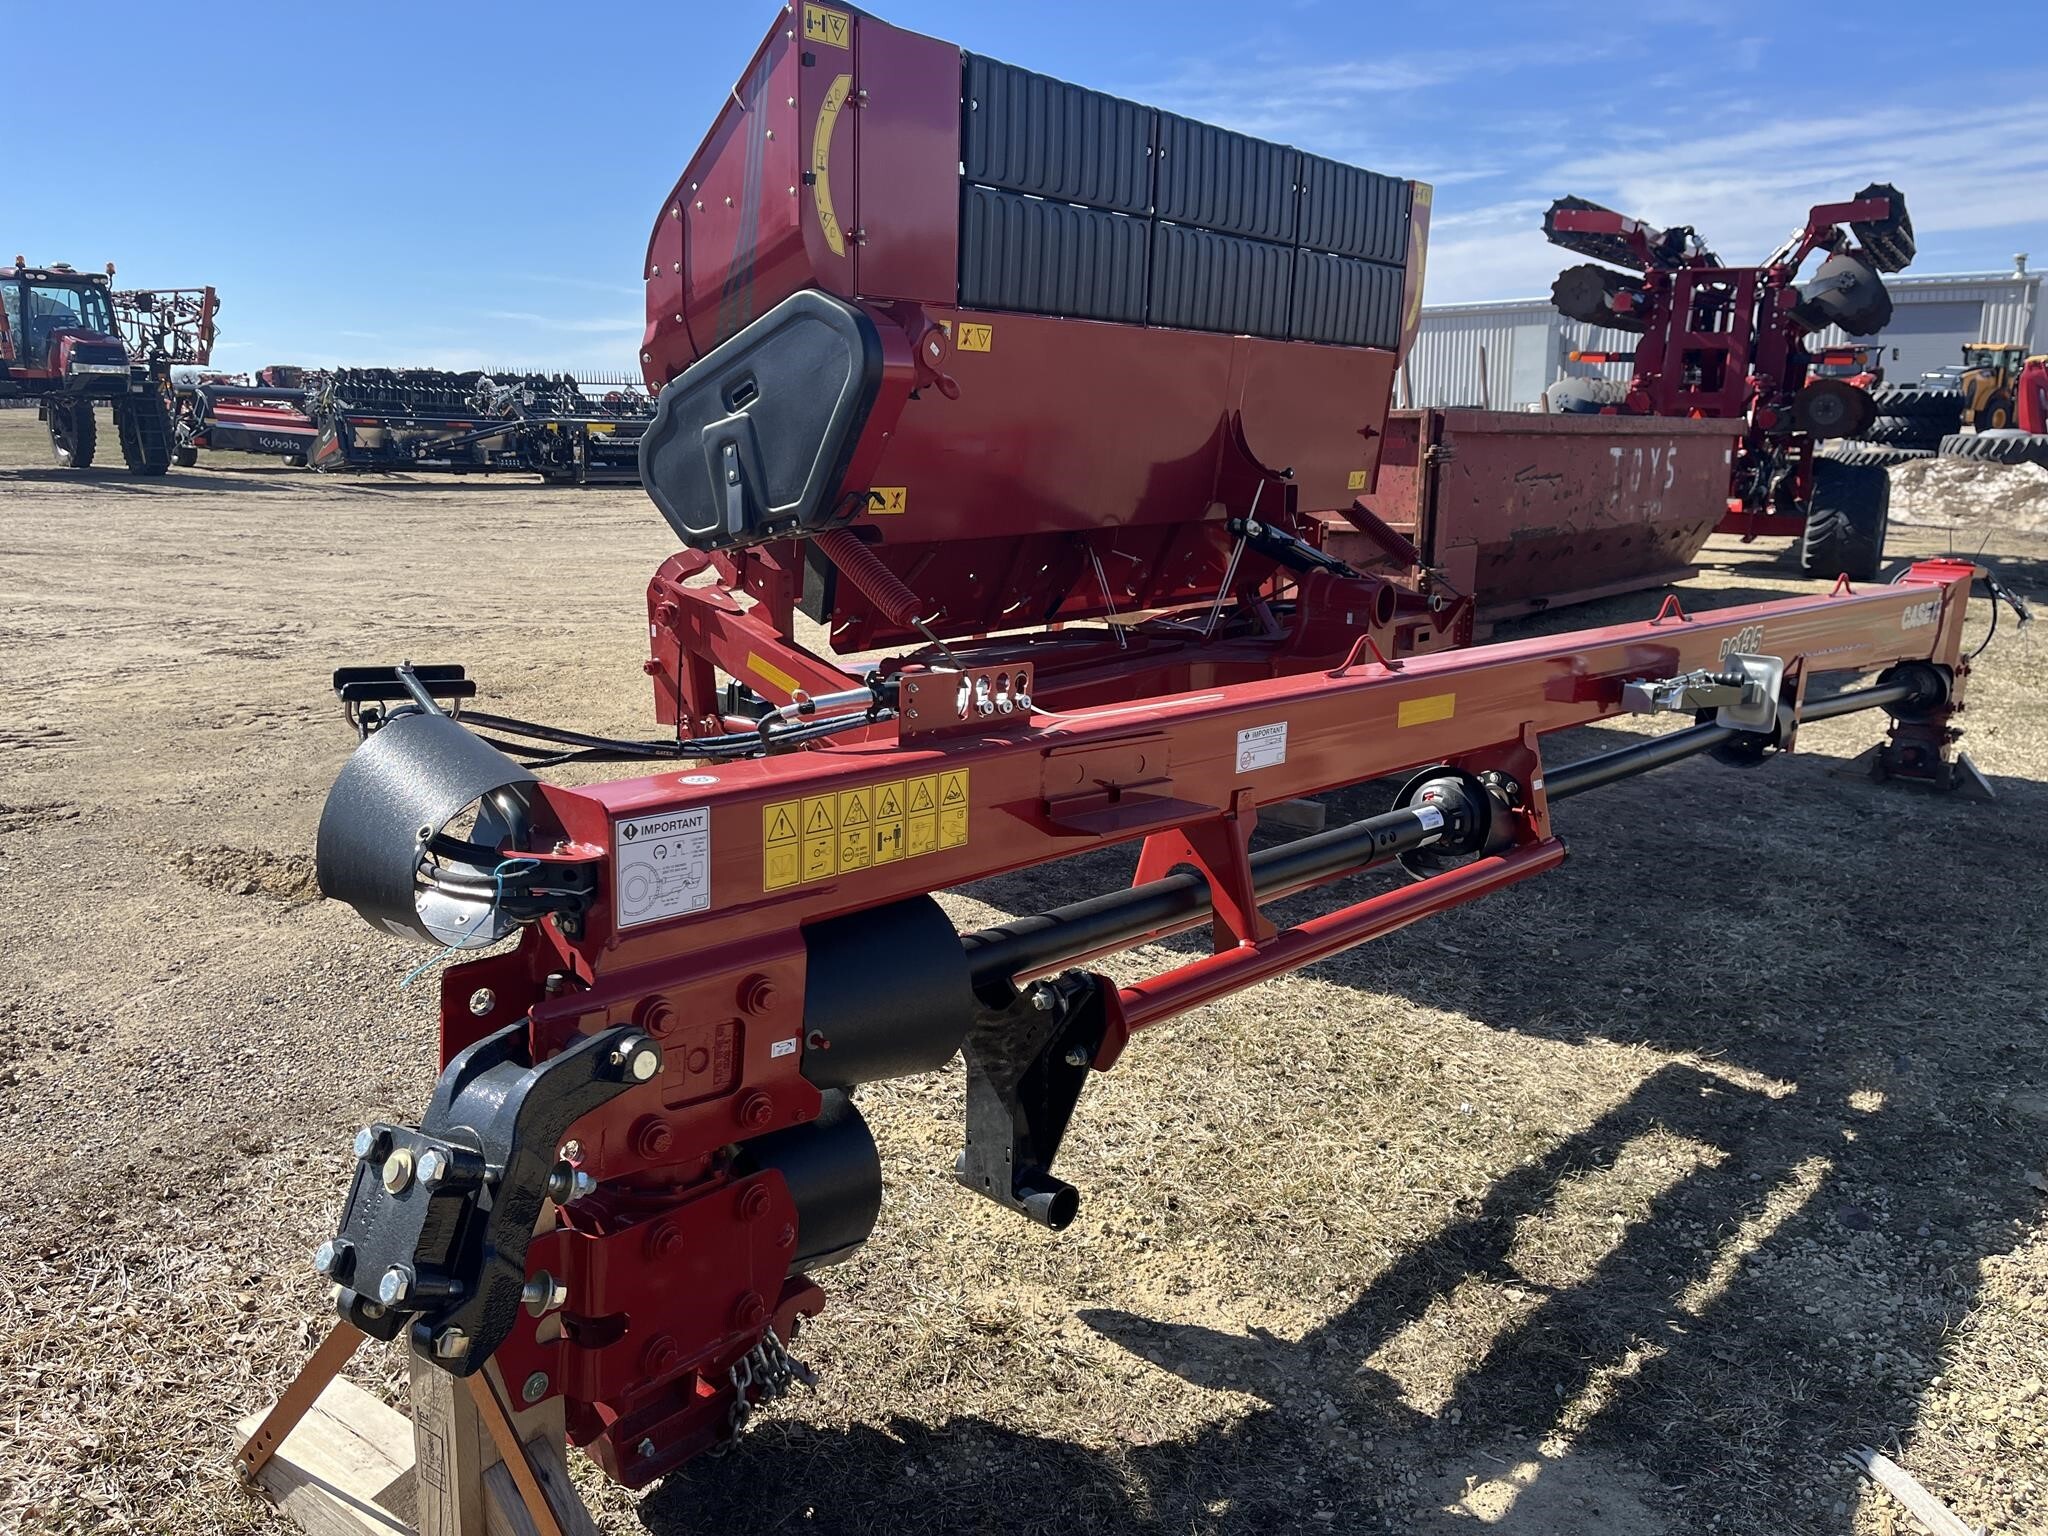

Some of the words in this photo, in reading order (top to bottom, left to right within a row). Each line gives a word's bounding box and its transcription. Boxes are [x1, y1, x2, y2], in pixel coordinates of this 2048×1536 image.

[259, 437, 301, 450] Kubota
[1609, 446, 1678, 493] TOYS
[1252, 726, 1284, 738] IMPORTANT
[640, 816, 704, 836] IMPORTANT
